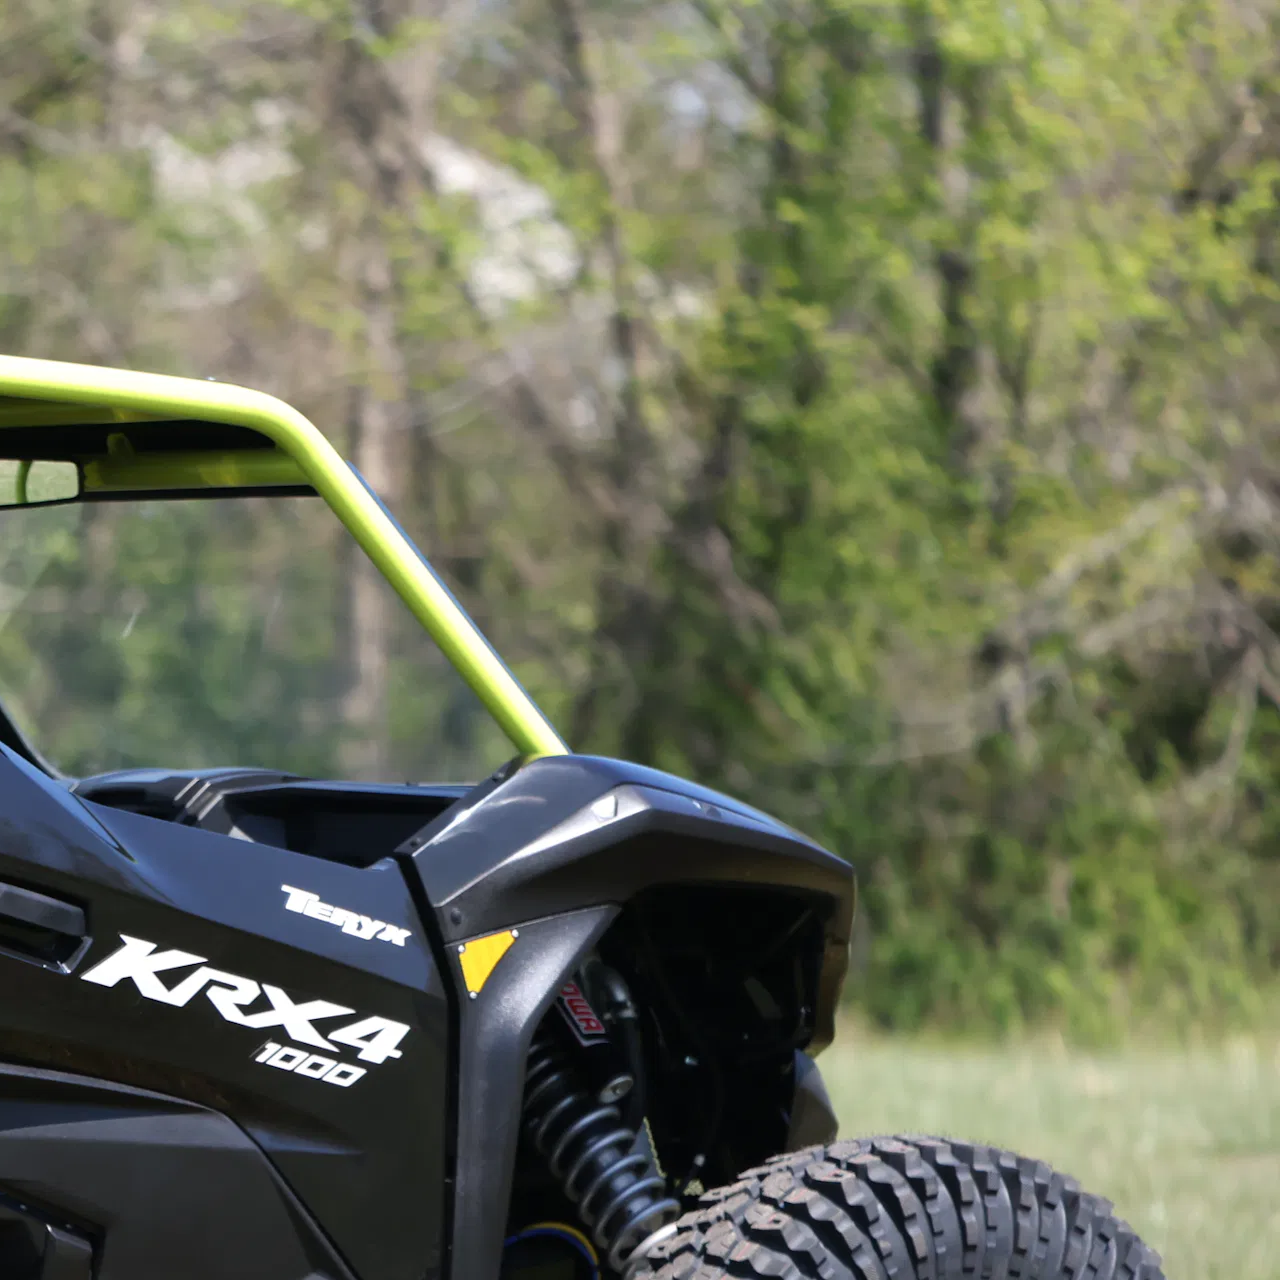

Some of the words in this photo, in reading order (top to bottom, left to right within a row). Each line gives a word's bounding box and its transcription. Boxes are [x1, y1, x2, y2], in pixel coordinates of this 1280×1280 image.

[81, 932, 411, 1064] KRX4
[561, 983, 605, 1033] OWA
[255, 1041, 367, 1088] 1000
